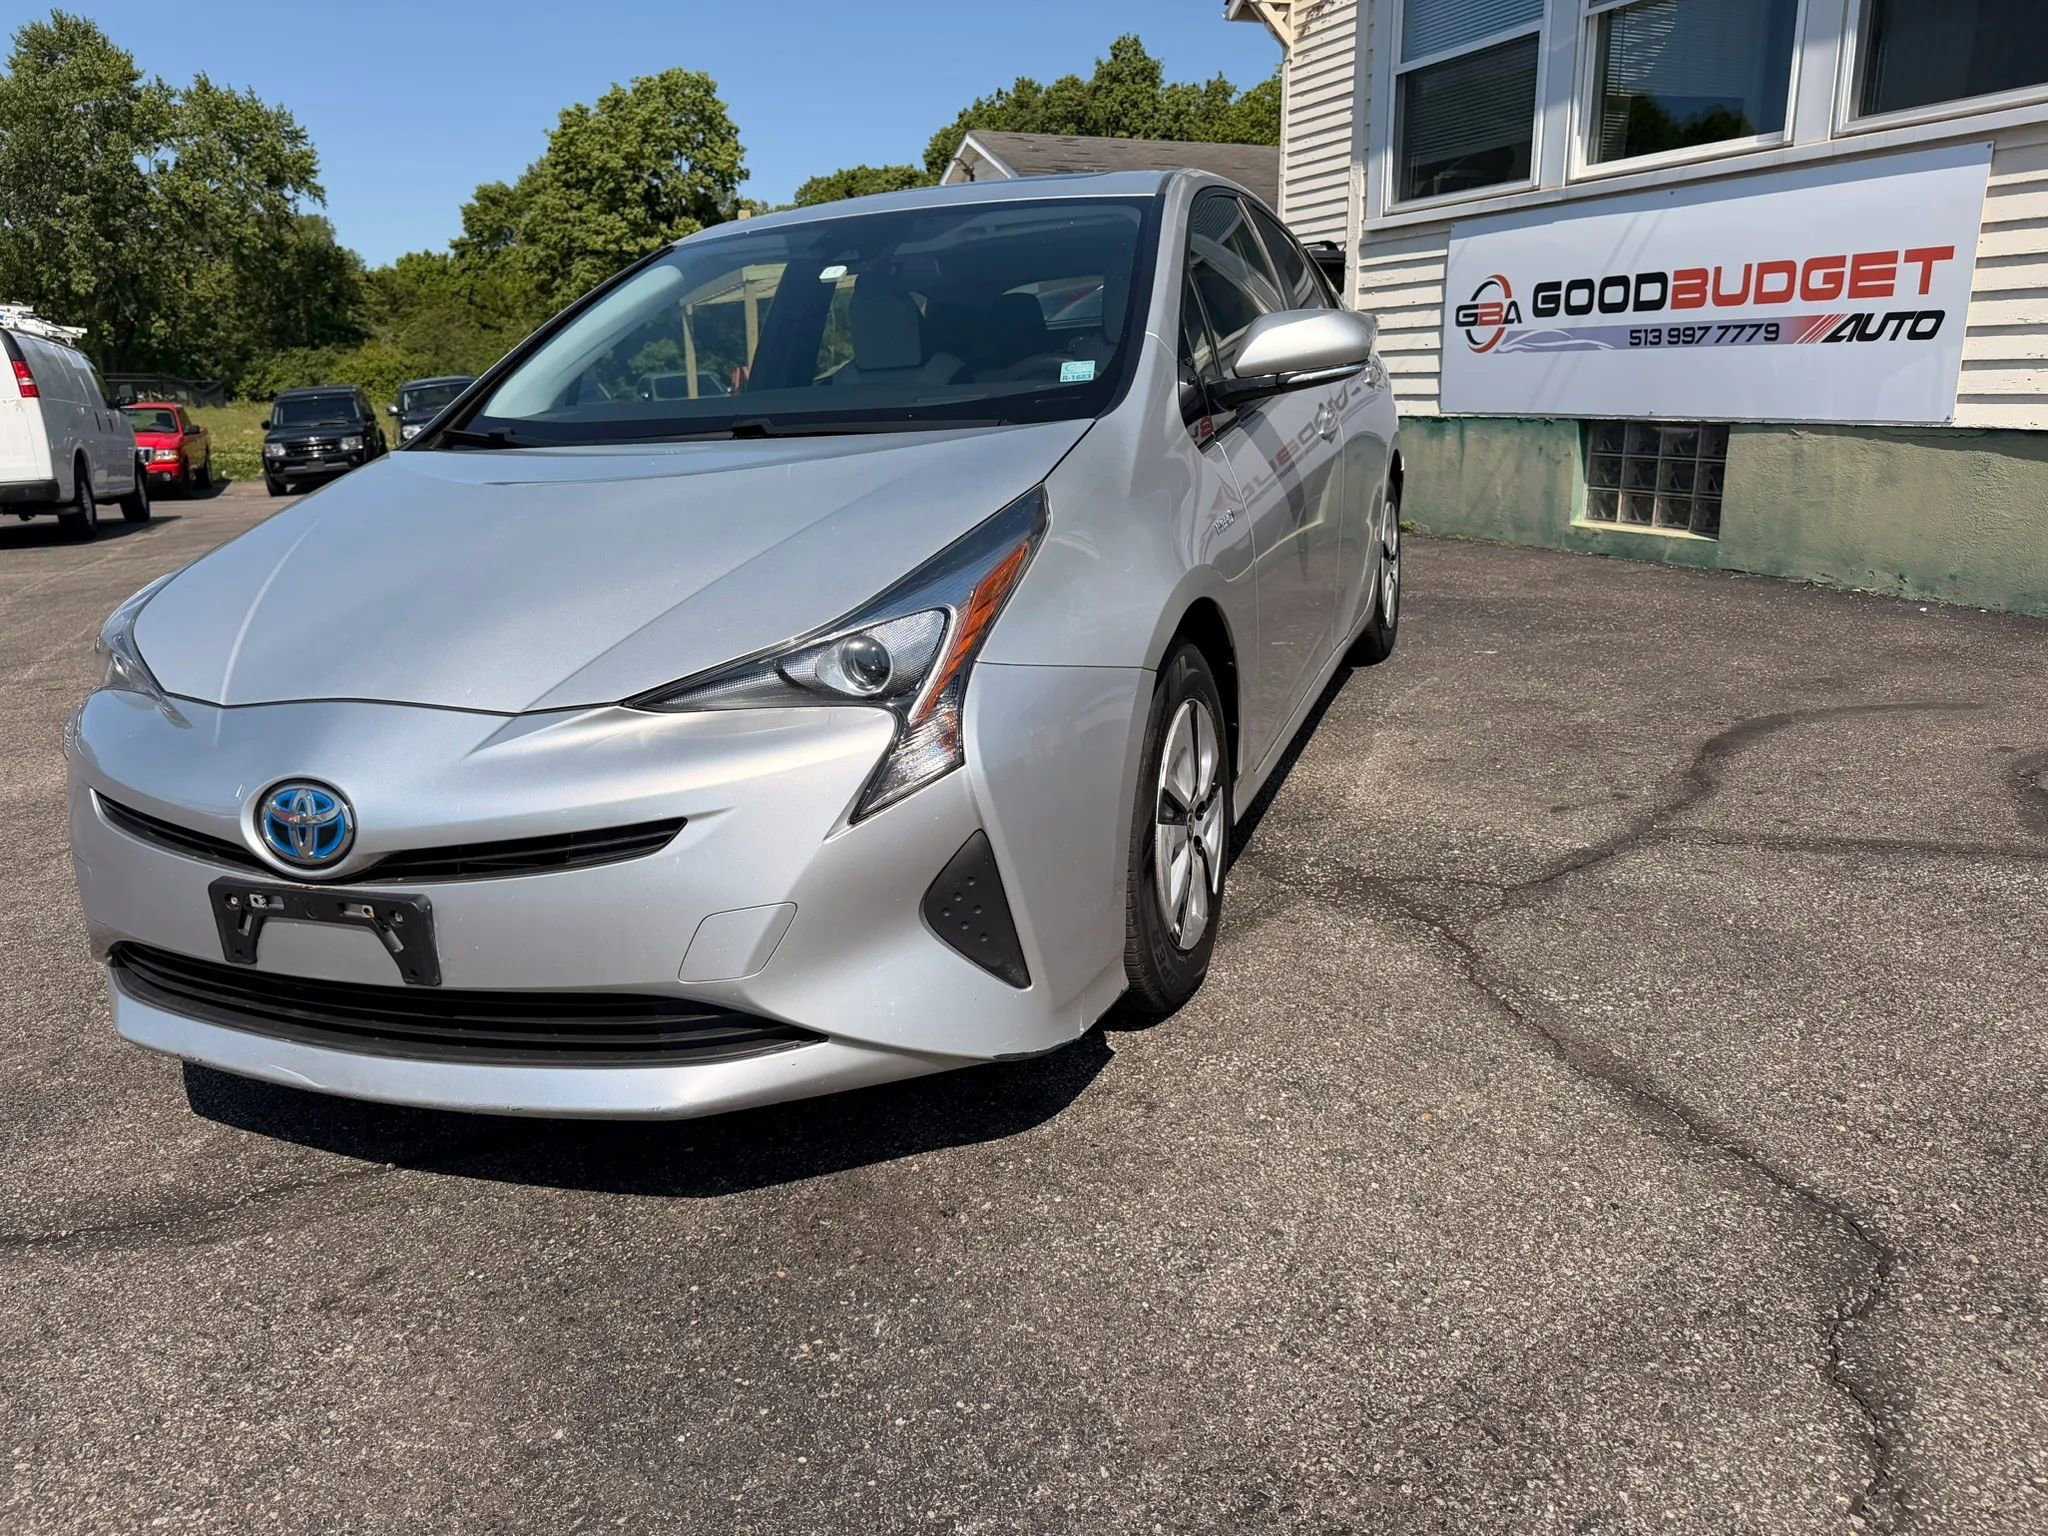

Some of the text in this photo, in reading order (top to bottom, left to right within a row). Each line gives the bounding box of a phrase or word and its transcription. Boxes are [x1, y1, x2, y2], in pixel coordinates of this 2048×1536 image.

[1455, 300, 1523, 327] GBA
[1821, 309, 1946, 343] AUTO
[1629, 322, 1780, 346] 513 997 7779
